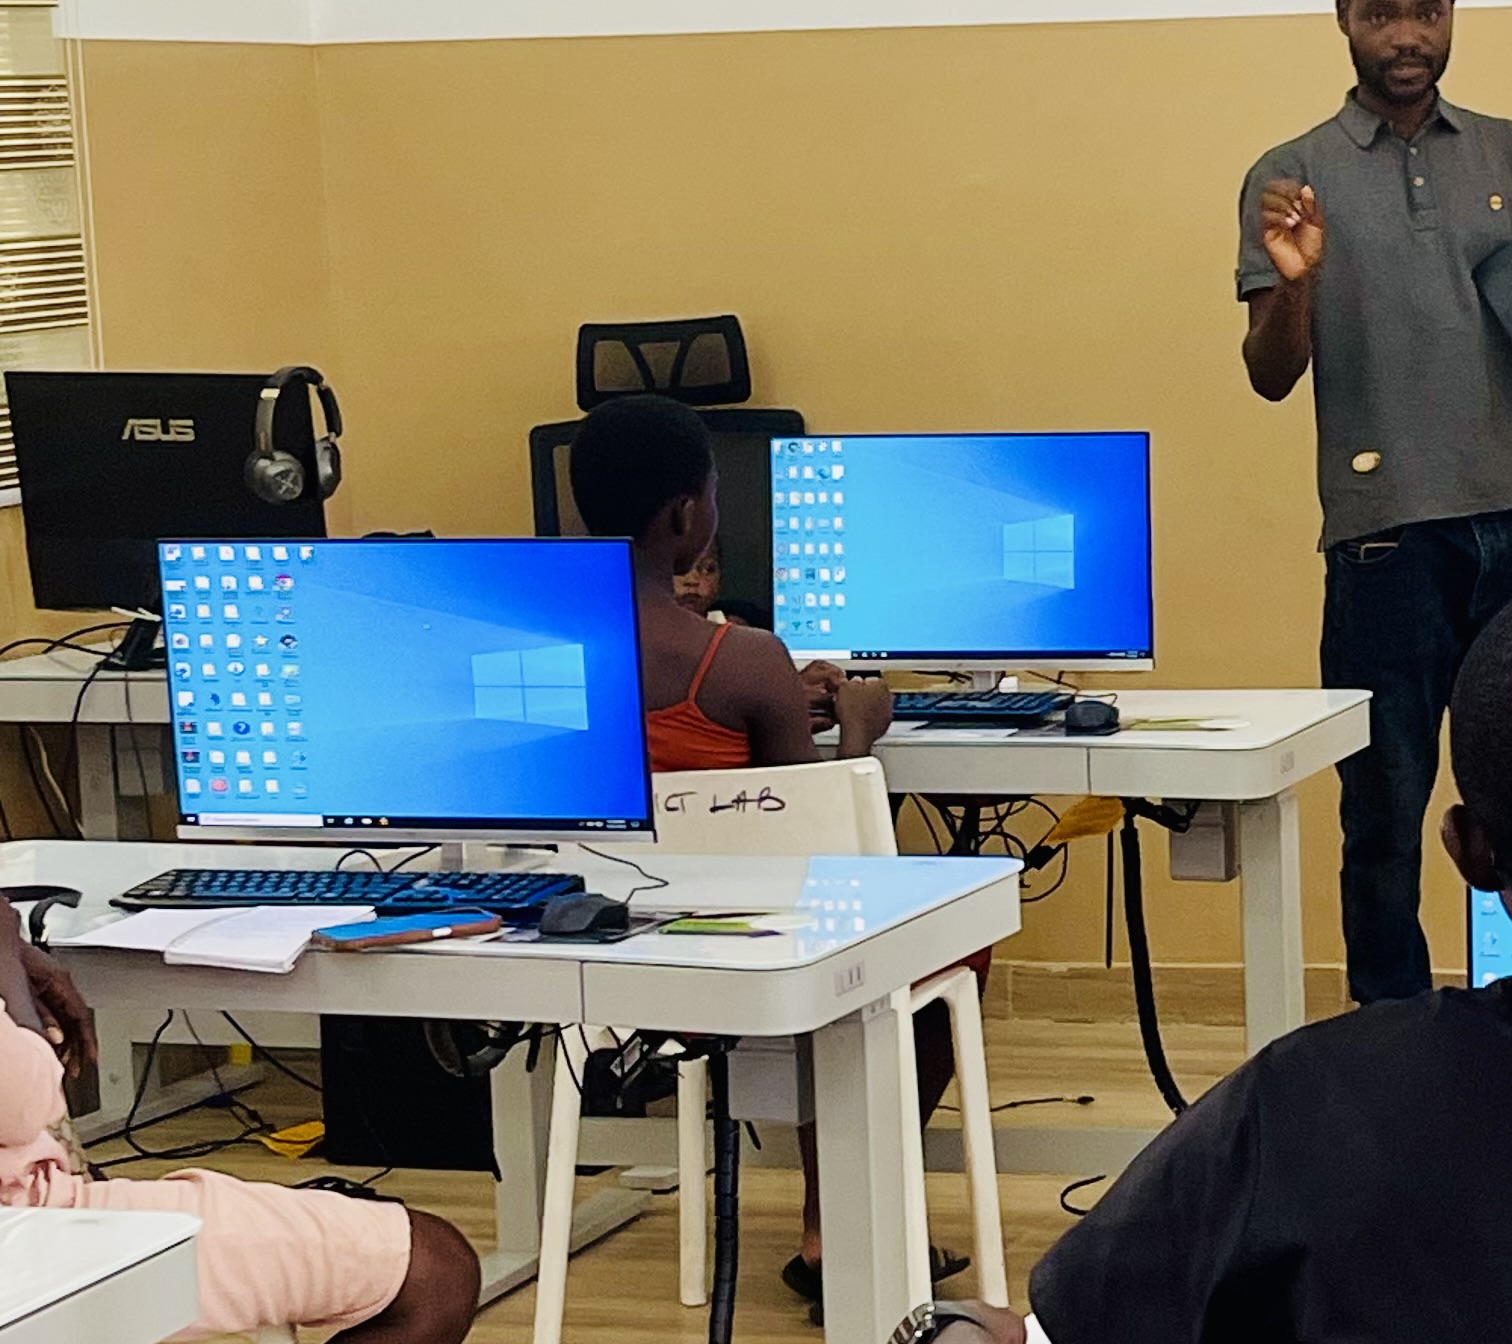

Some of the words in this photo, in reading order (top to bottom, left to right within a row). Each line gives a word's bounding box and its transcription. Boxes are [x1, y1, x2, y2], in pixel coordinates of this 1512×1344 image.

[122, 418, 195, 442] ASUS
[655, 792, 698, 813] ICT
[709, 786, 786, 813] LAB
